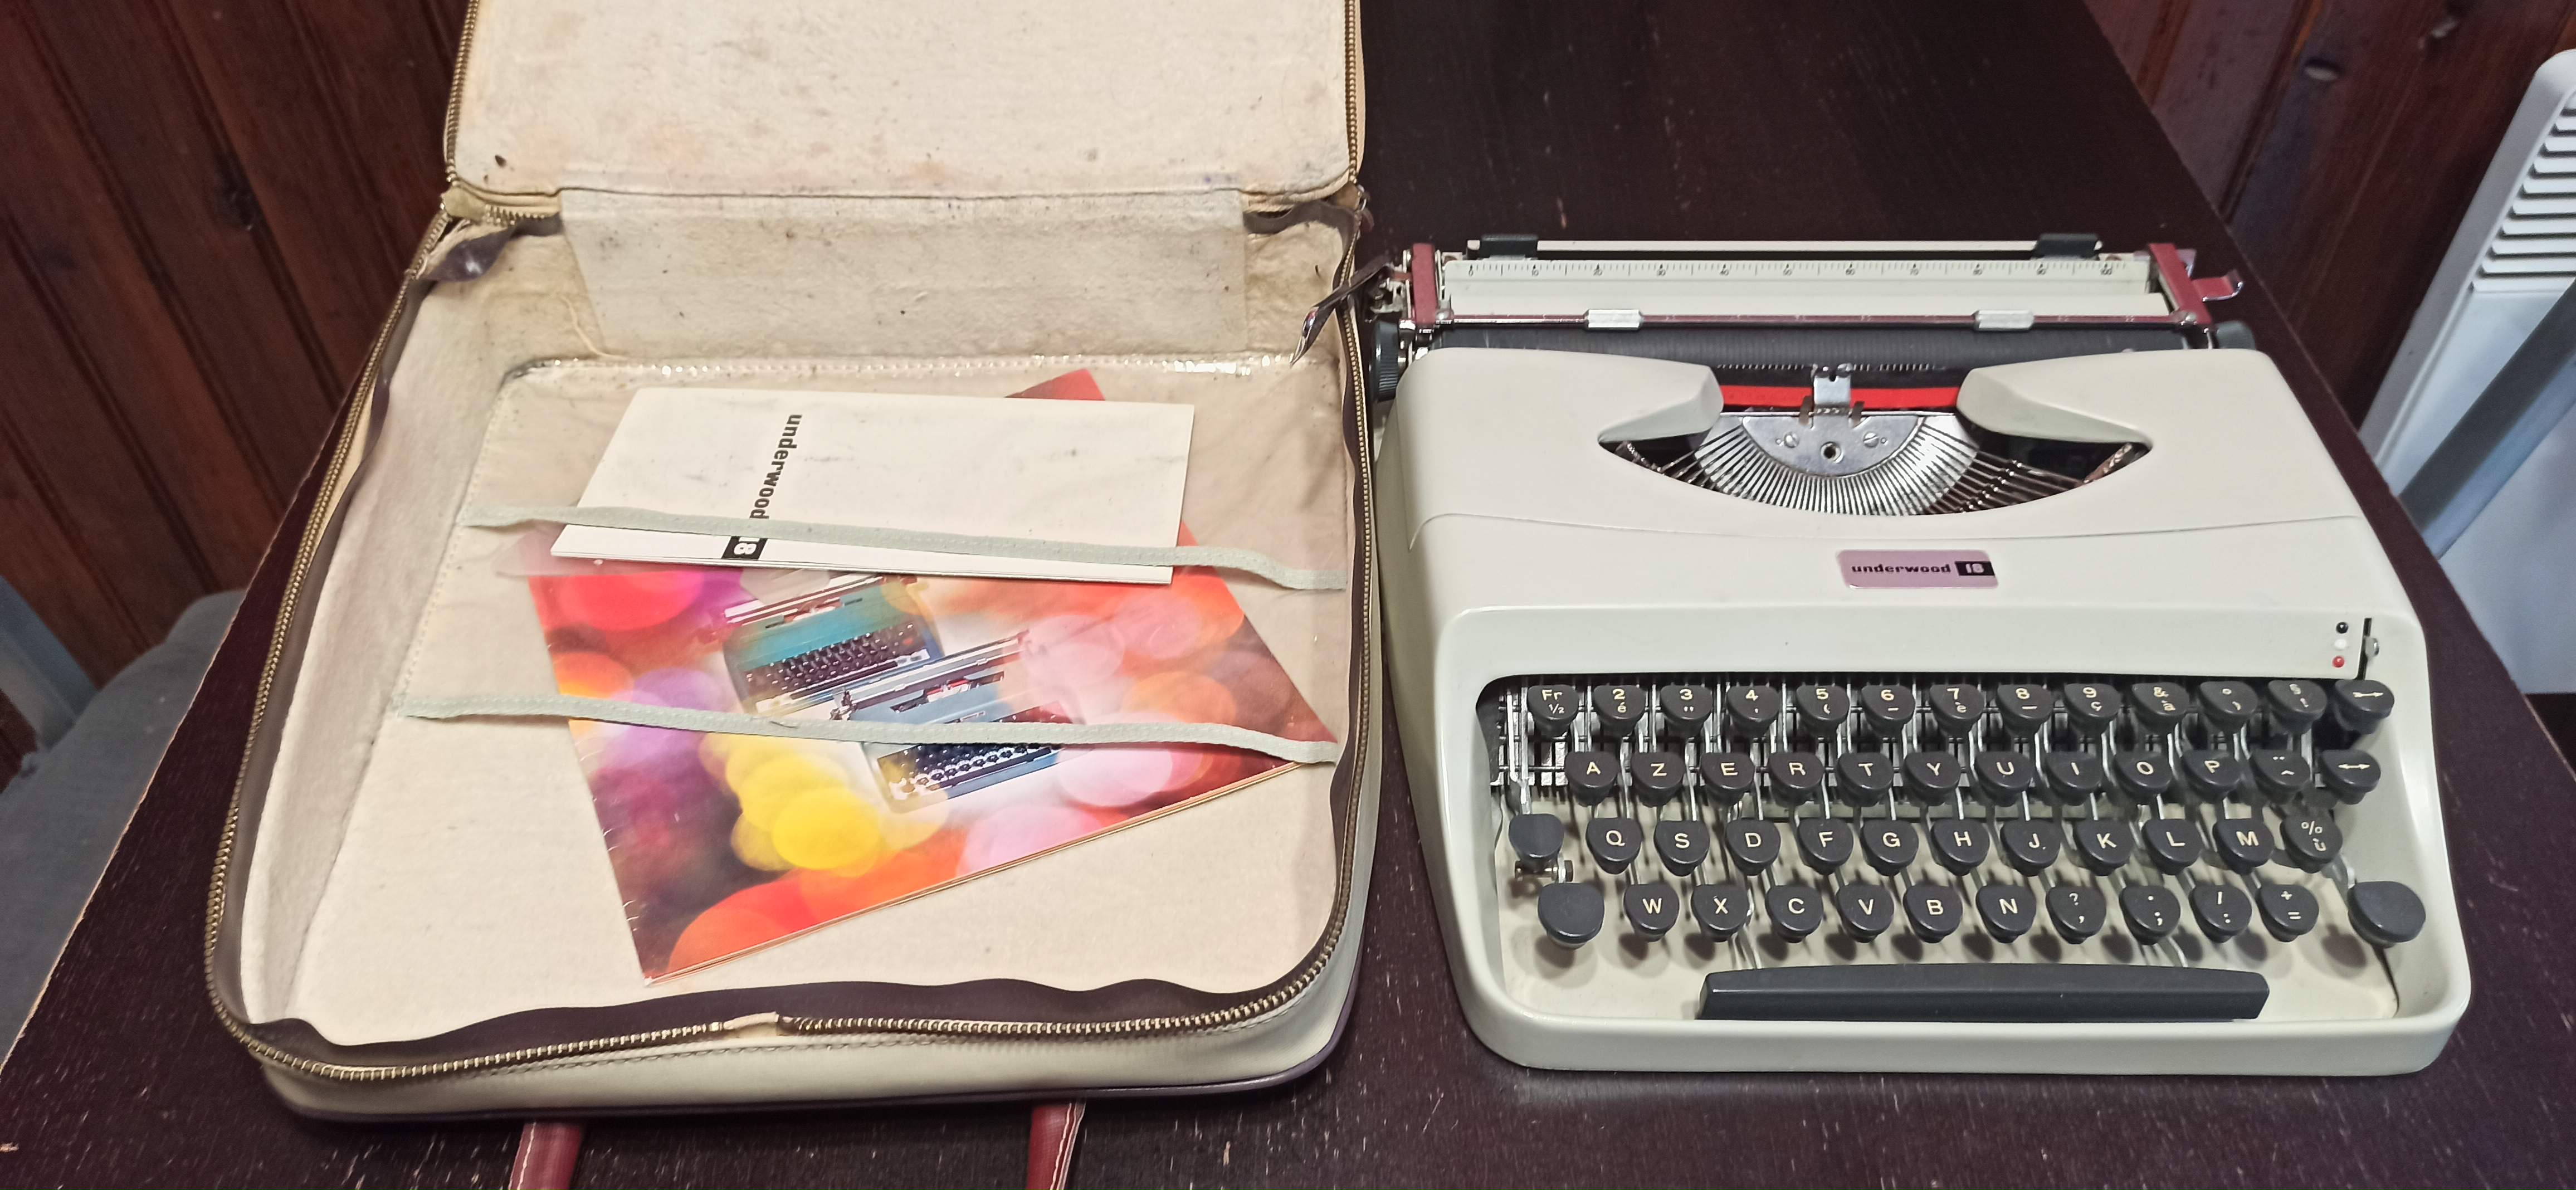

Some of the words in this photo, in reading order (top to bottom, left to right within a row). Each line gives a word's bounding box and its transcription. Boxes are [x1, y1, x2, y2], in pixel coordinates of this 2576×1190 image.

[749, 414, 803, 519] underwood
[1851, 564, 1951, 573] underwood
[1612, 689, 1626, 700] 2
[1680, 689, 1693, 700] 3
[1745, 690, 1759, 701] 4
[1816, 689, 1829, 699] 5
[1881, 690, 1895, 701] 6
[1946, 688, 1959, 700] 7
[2016, 687, 2030, 699] 8
[2082, 687, 2096, 698] 9
[1587, 762, 1601, 775] A
[1650, 763, 1667, 777] Z
[1720, 762, 1739, 776] E
[1789, 762, 1806, 776] R
[1858, 763, 1874, 776] T
[1926, 762, 1941, 776] Y
[1996, 762, 2014, 776] U
[2071, 762, 2080, 776] I
[2136, 762, 2154, 775] O
[2204, 760, 2220, 773] P
[1606, 830, 1626, 847] Q
[1674, 833, 1690, 848] S
[1744, 832, 1762, 847] D
[1818, 831, 1833, 847] F
[1882, 832, 1901, 847] G
[1953, 831, 1972, 847] H
[2028, 833, 2040, 848] J
[2096, 833, 2117, 849] K
[2165, 831, 2186, 847] L
[2236, 831, 2259, 846] M
[2301, 821, 2323, 835] %
[1642, 898, 1662, 914] W
[1713, 895, 1729, 914] X
[1788, 898, 1805, 914] C
[1858, 899, 1874, 915] V
[1926, 899, 1944, 915] B
[1999, 898, 2018, 915] N
[2069, 892, 2079, 906] ?
